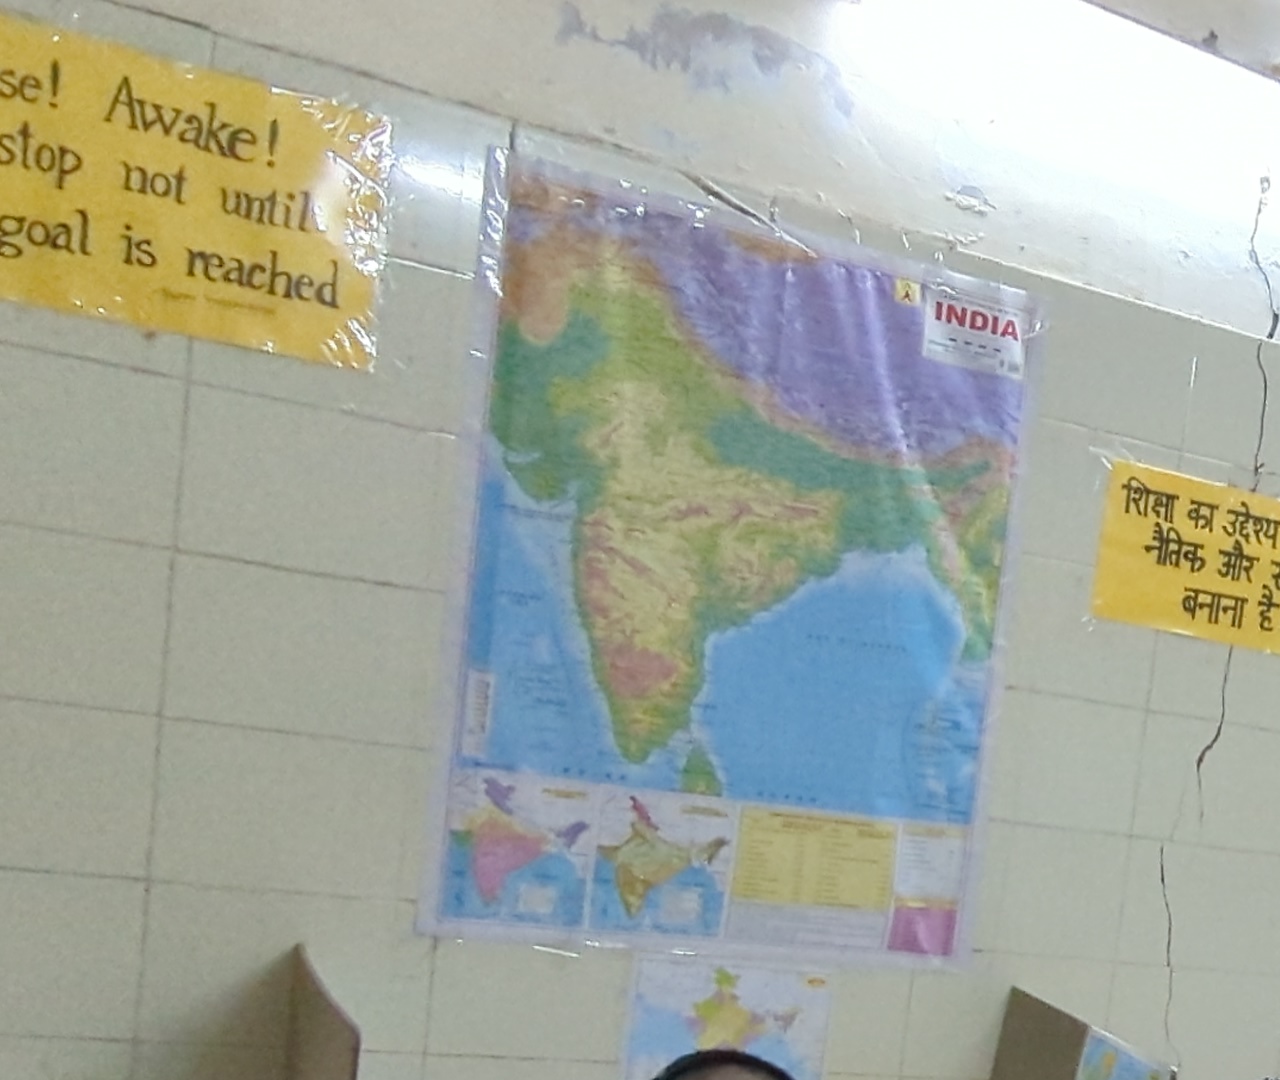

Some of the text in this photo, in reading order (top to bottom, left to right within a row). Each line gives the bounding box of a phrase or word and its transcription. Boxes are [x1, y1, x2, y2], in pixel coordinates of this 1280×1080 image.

[104, 76, 279, 167] Awake!
[0, 121, 328, 232] stop not until
[0, 209, 91, 258] goal
[121, 225, 157, 267] is
[186, 247, 339, 309] reached
[935, 301, 1018, 342] INDIA
[1122, 476, 1179, 524] शिक्षा
[1188, 499, 1218, 533] का
[1144, 521, 1206, 573] नैतिक
[1217, 539, 1260, 583] और
[1182, 586, 1249, 630] बनाना
